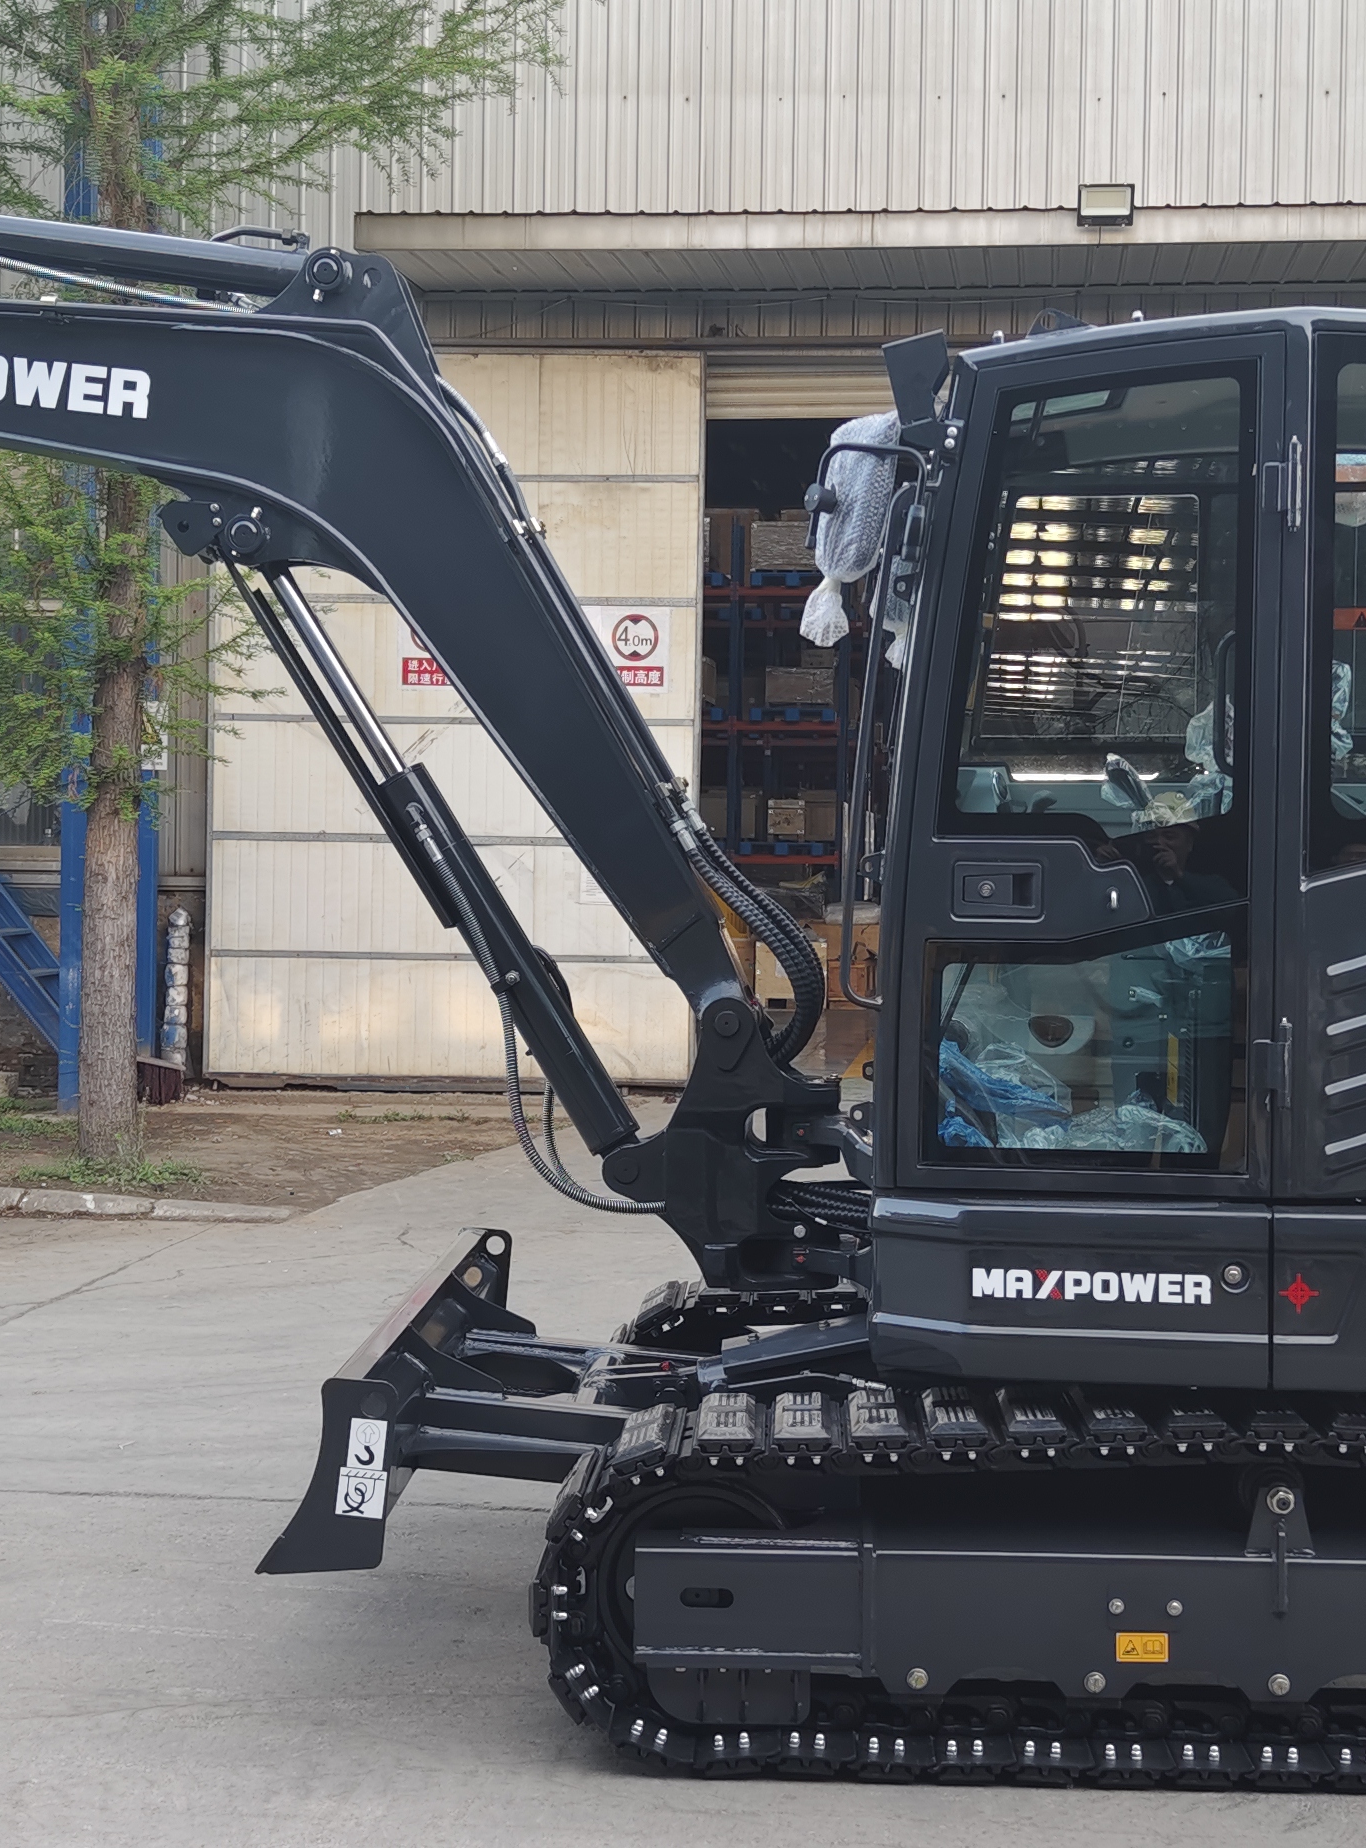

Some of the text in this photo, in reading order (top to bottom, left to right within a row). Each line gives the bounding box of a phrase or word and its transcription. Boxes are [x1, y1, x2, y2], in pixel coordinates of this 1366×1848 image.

[617, 670, 661, 684] 制高度
[972, 1268, 1212, 1304] MAXPOWER
